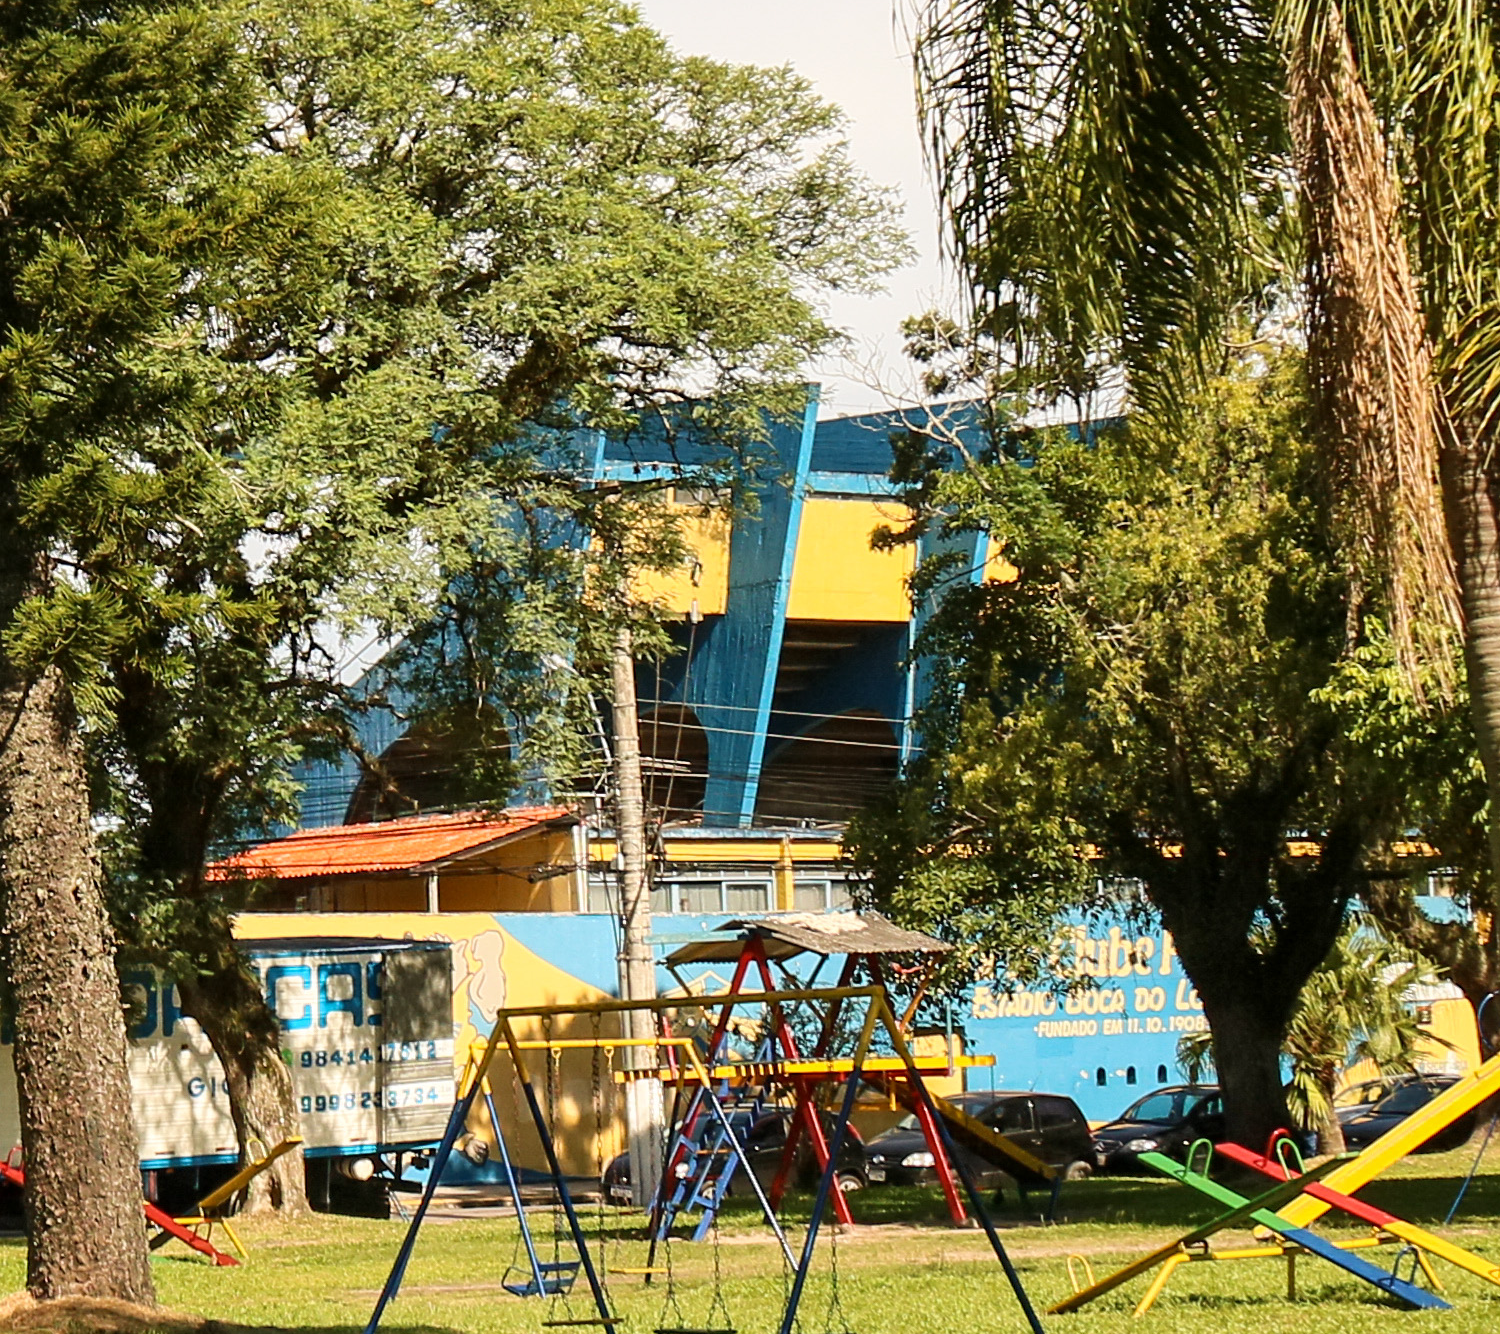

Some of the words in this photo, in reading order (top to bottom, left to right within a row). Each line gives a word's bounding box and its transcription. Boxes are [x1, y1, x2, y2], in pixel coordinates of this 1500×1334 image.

[1134, 986, 1167, 1012] DO
[1037, 1019, 1098, 1038] FUNDADO
[1102, 1017, 1123, 1035] EM
